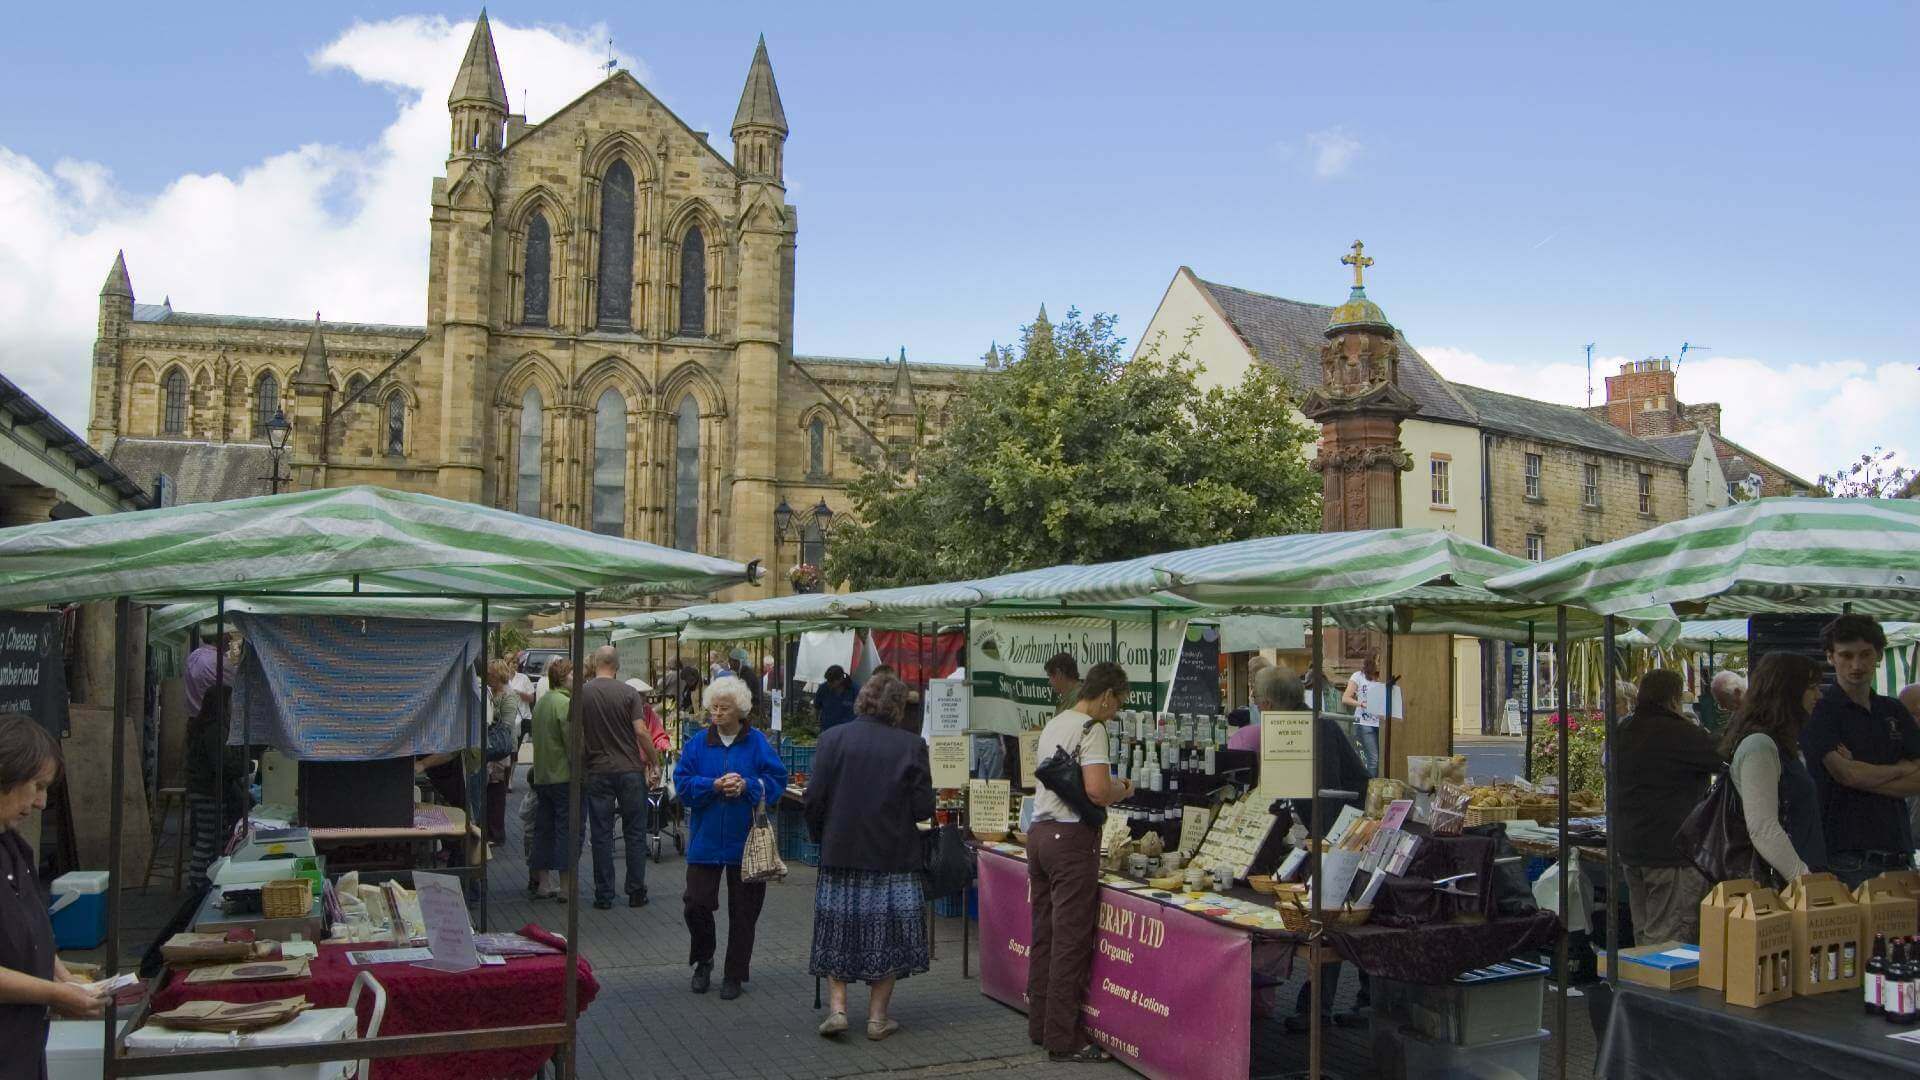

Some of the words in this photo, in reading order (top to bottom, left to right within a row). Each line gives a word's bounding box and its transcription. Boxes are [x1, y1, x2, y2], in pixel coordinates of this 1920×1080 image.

[7, 626, 38, 651] Cheeses
[1008, 633, 1078, 664] Northumbria
[1082, 632, 1112, 664] Soup
[1117, 640, 1177, 667] Coman
[0, 661, 40, 686] umberland
[1099, 902, 1137, 939] ERAPY
[1139, 915, 1165, 949] LTD
[1812, 928, 1855, 940] BREWERY
[1008, 939, 1025, 957] Soap
[1100, 938, 1134, 965] Organic
[1102, 977, 1130, 1001] Creams
[1131, 990, 1138, 1003] &
[1138, 993, 1170, 1017] Lotions
[1094, 1028, 1109, 1044] 0191
